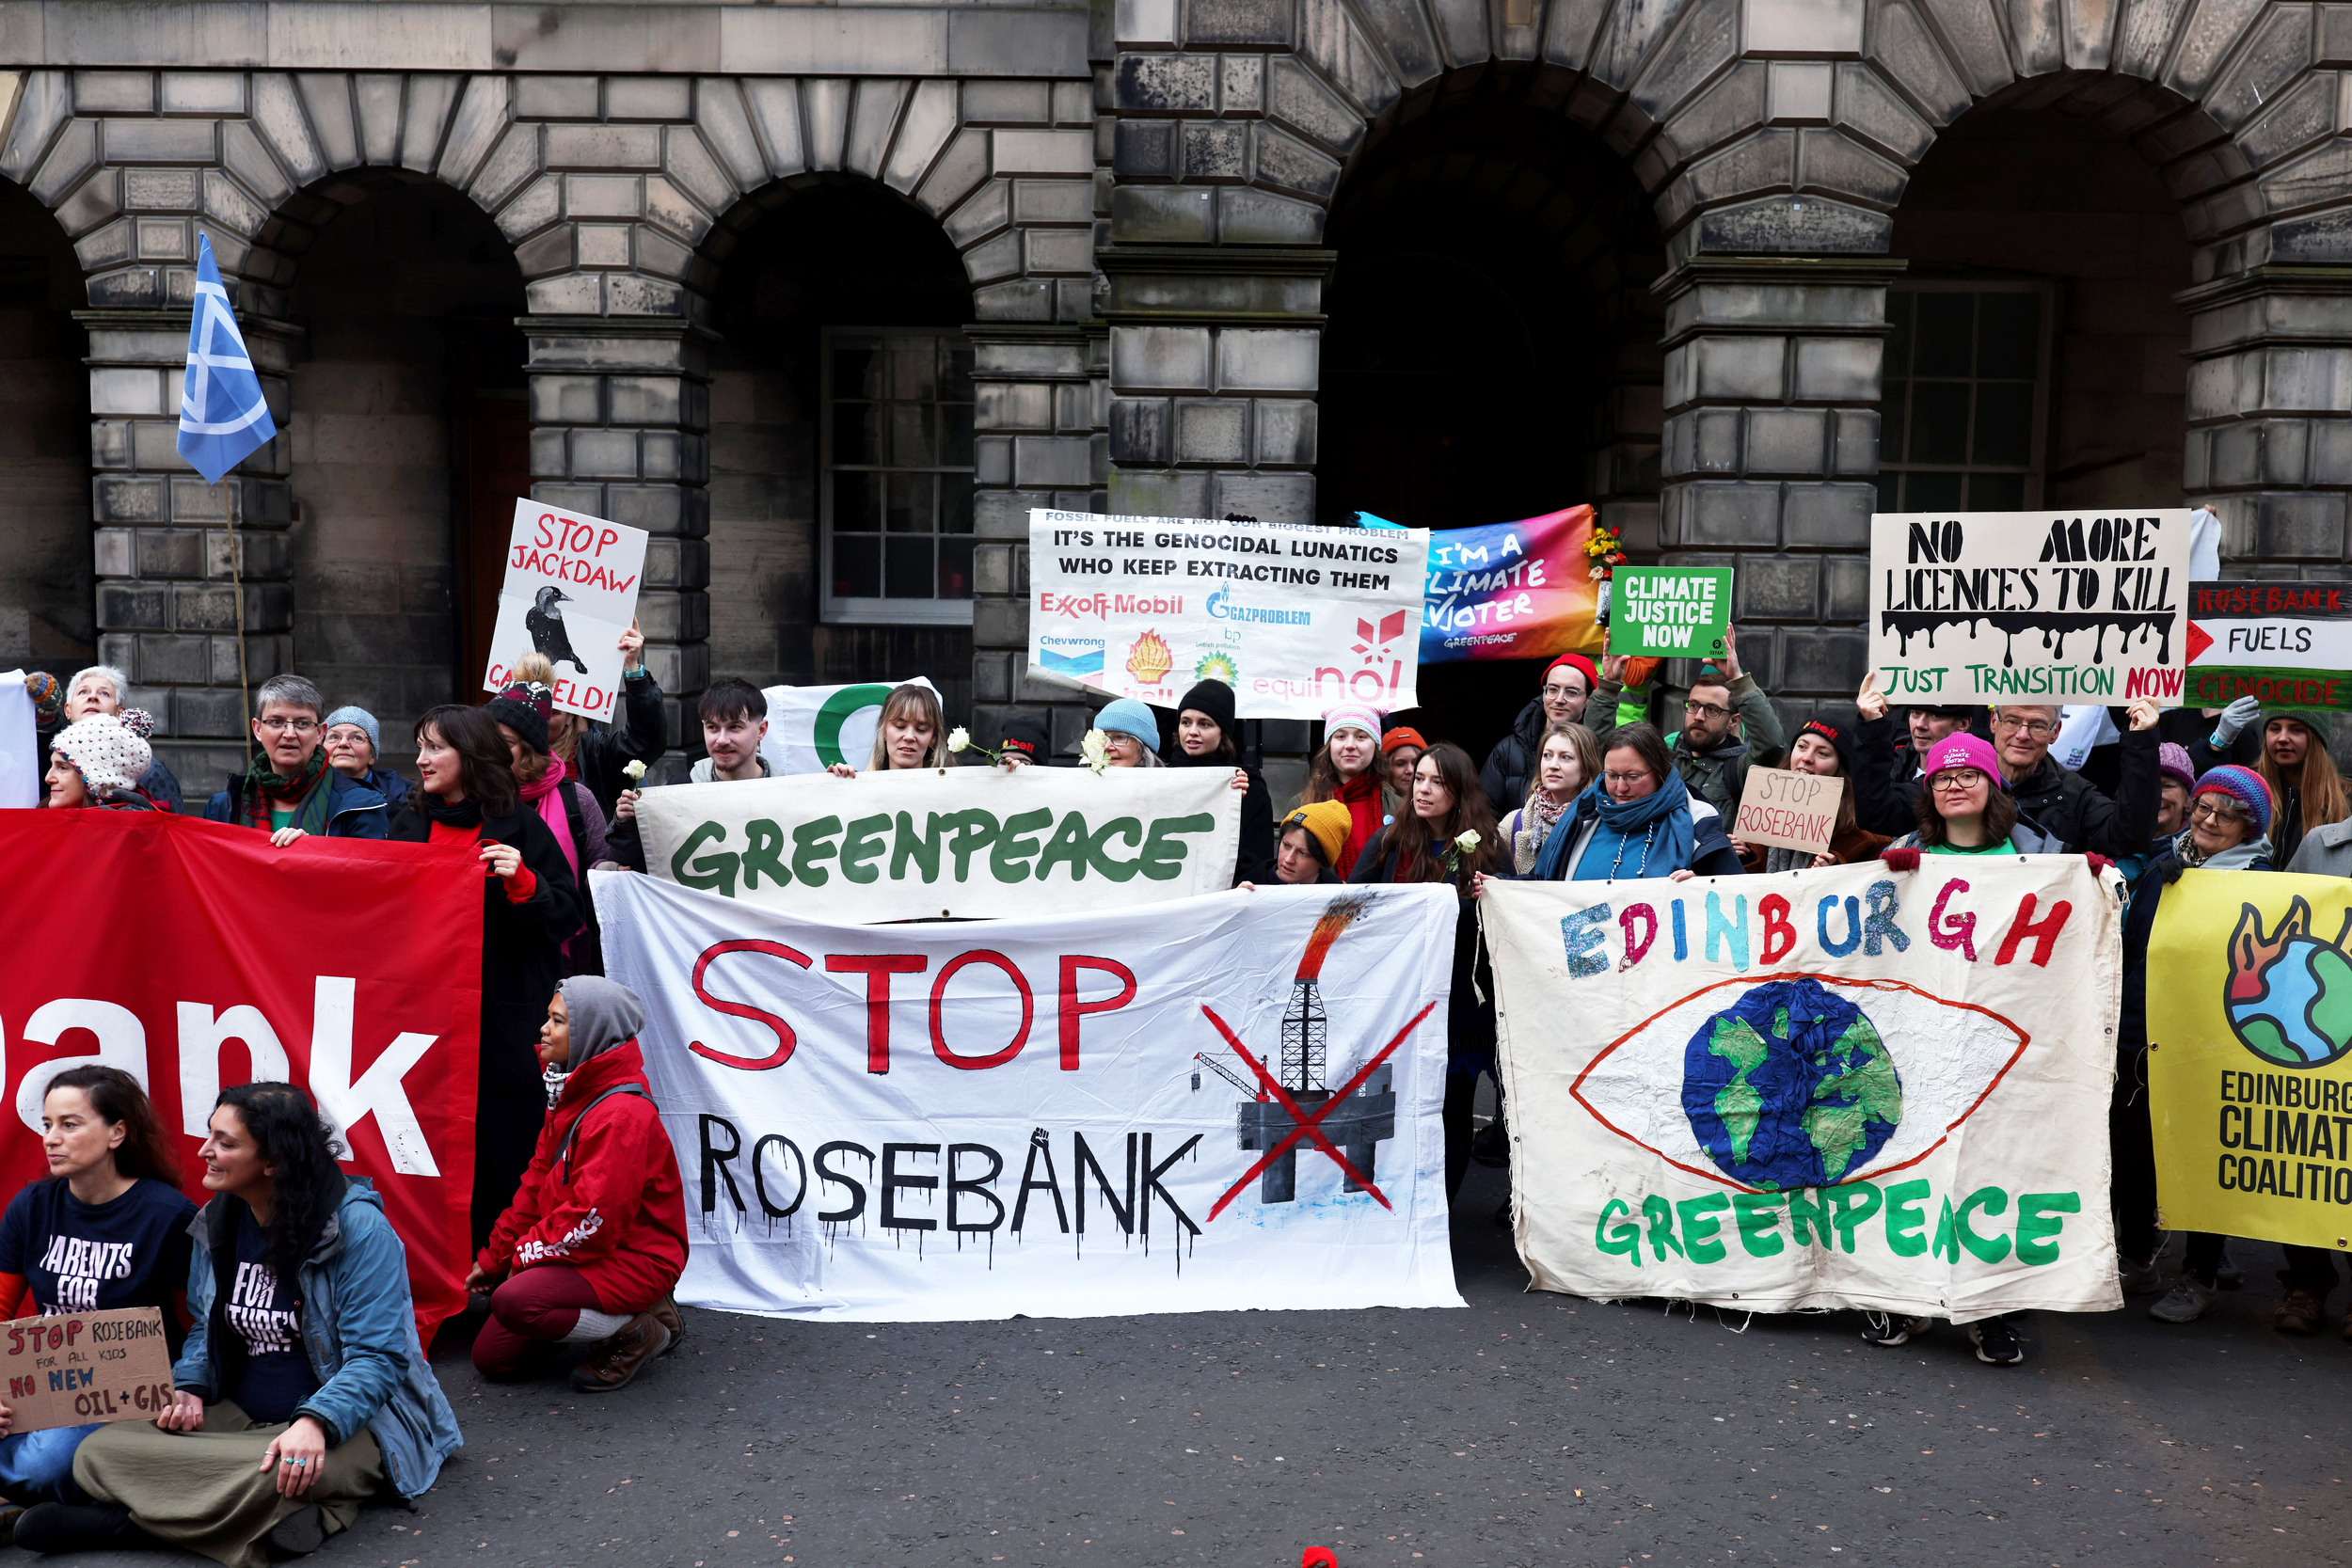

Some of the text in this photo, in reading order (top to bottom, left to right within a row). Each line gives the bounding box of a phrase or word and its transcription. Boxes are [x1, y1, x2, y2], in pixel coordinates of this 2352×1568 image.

[534, 514, 618, 557] STOP
[1045, 512, 1097, 522] FOSSIL
[1104, 514, 1150, 524] FUELS
[1338, 527, 1409, 540] PROBLEM
[1907, 517, 2161, 564] NO MORE
[1054, 530, 1399, 564] IT'S THE GENOCIDAL LUNATICS
[1435, 533, 1523, 565] I'M A
[511, 546, 636, 594] JACKDAW
[1058, 557, 1391, 591] WHO KEEP EXTRACTING THEM
[1625, 576, 1718, 601] CLIMATE
[1886, 566, 2177, 611] LICENCES TO KILL
[2197, 586, 2343, 613] ROSEBANK
[1230, 606, 1311, 626] GAZPROBLEM
[1624, 599, 1714, 625] JUSTICE
[1040, 635, 1105, 649] Chevwrong
[1216, 642, 1241, 651] pollution
[1224, 626, 1242, 643] bp
[1443, 632, 1518, 648] GREENPEACE
[1642, 624, 1694, 649] NOW
[2228, 626, 2312, 654] FUELS
[1879, 666, 1950, 696] JUST
[2124, 666, 2185, 700] NOW
[2197, 673, 2342, 705] GENOCIDE
[1009, 737, 1035, 753] hell
[1809, 720, 1839, 741] hell
[1759, 772, 1821, 806] STOP
[1736, 804, 1833, 845] ROSEBANK
[671, 807, 1216, 898] GREENPEACE
[1560, 878, 2074, 980] EDINBURGH
[689, 939, 1137, 1076] STOP
[698, 1113, 1205, 1260] ROSEBANK
[1595, 1178, 2082, 1267] GREENPEACE
[57, 1275, 98, 1311] FOR
[8, 1319, 163, 1355] STOP ROSEBANK
[36, 1348, 127, 1370] FOR ALL KIDS
[9, 1367, 94, 1400] NO NEW
[74, 1383, 173, 1417] OIL + GAS
